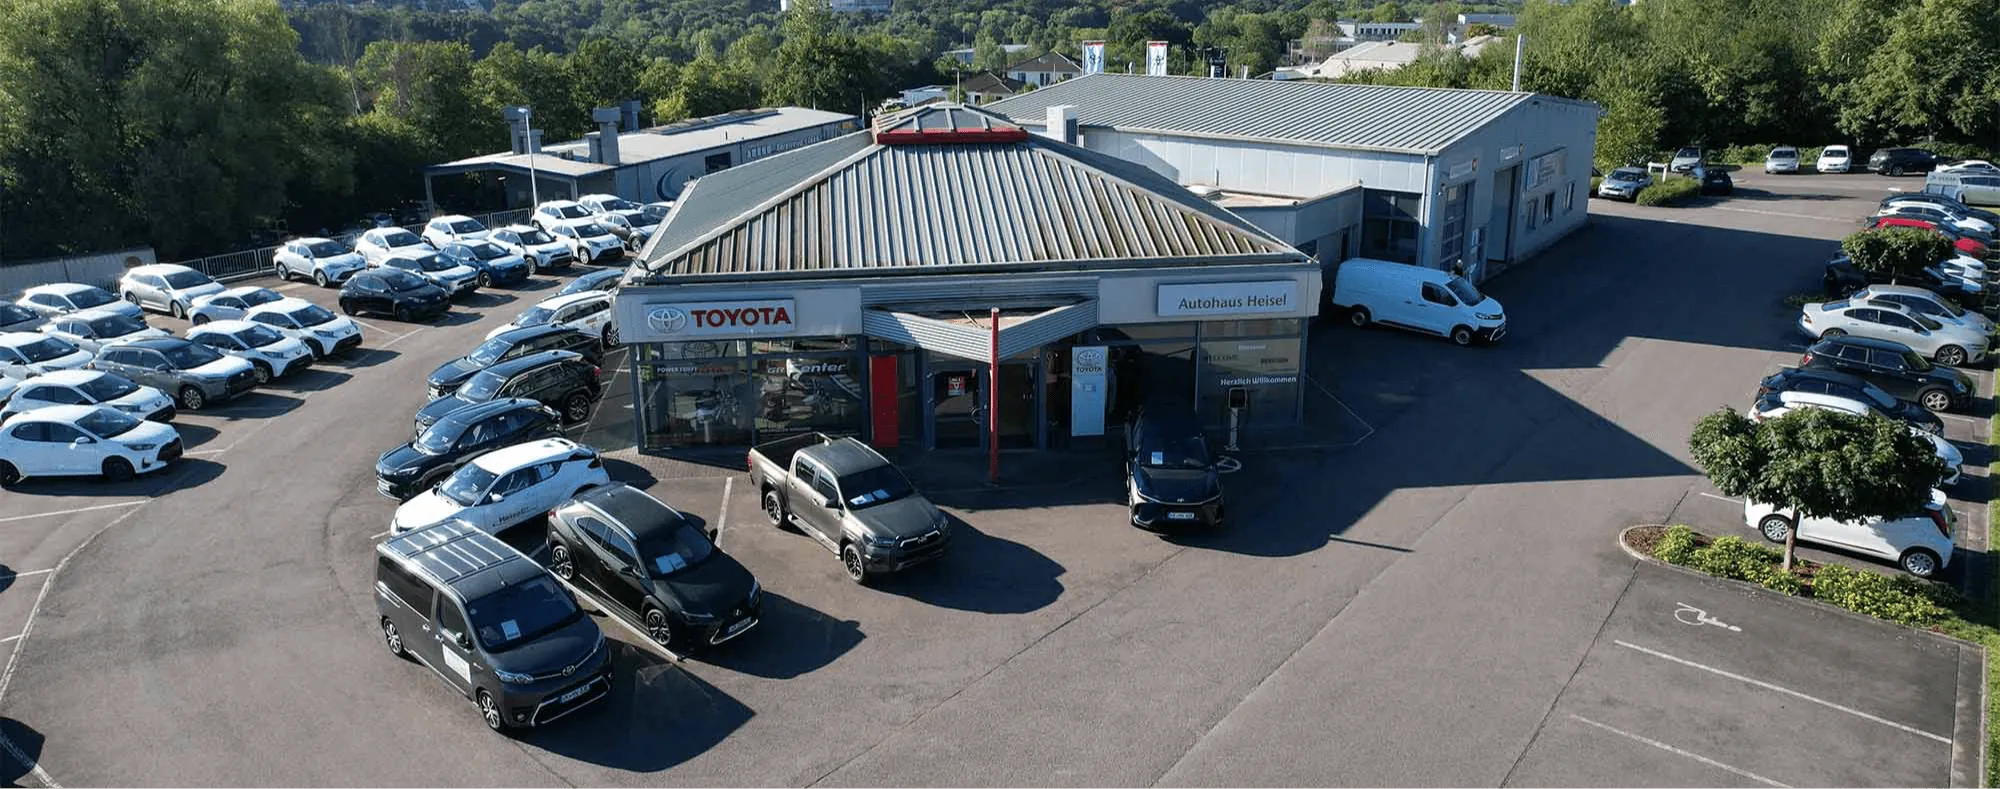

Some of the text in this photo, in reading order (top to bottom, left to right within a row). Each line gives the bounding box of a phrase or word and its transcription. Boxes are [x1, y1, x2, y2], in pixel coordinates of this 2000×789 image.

[1178, 293, 1287, 310] Autohaus Heisel
[691, 307, 792, 328] TOYOTA
[1220, 376, 1297, 386] Herzlich Willkommen
